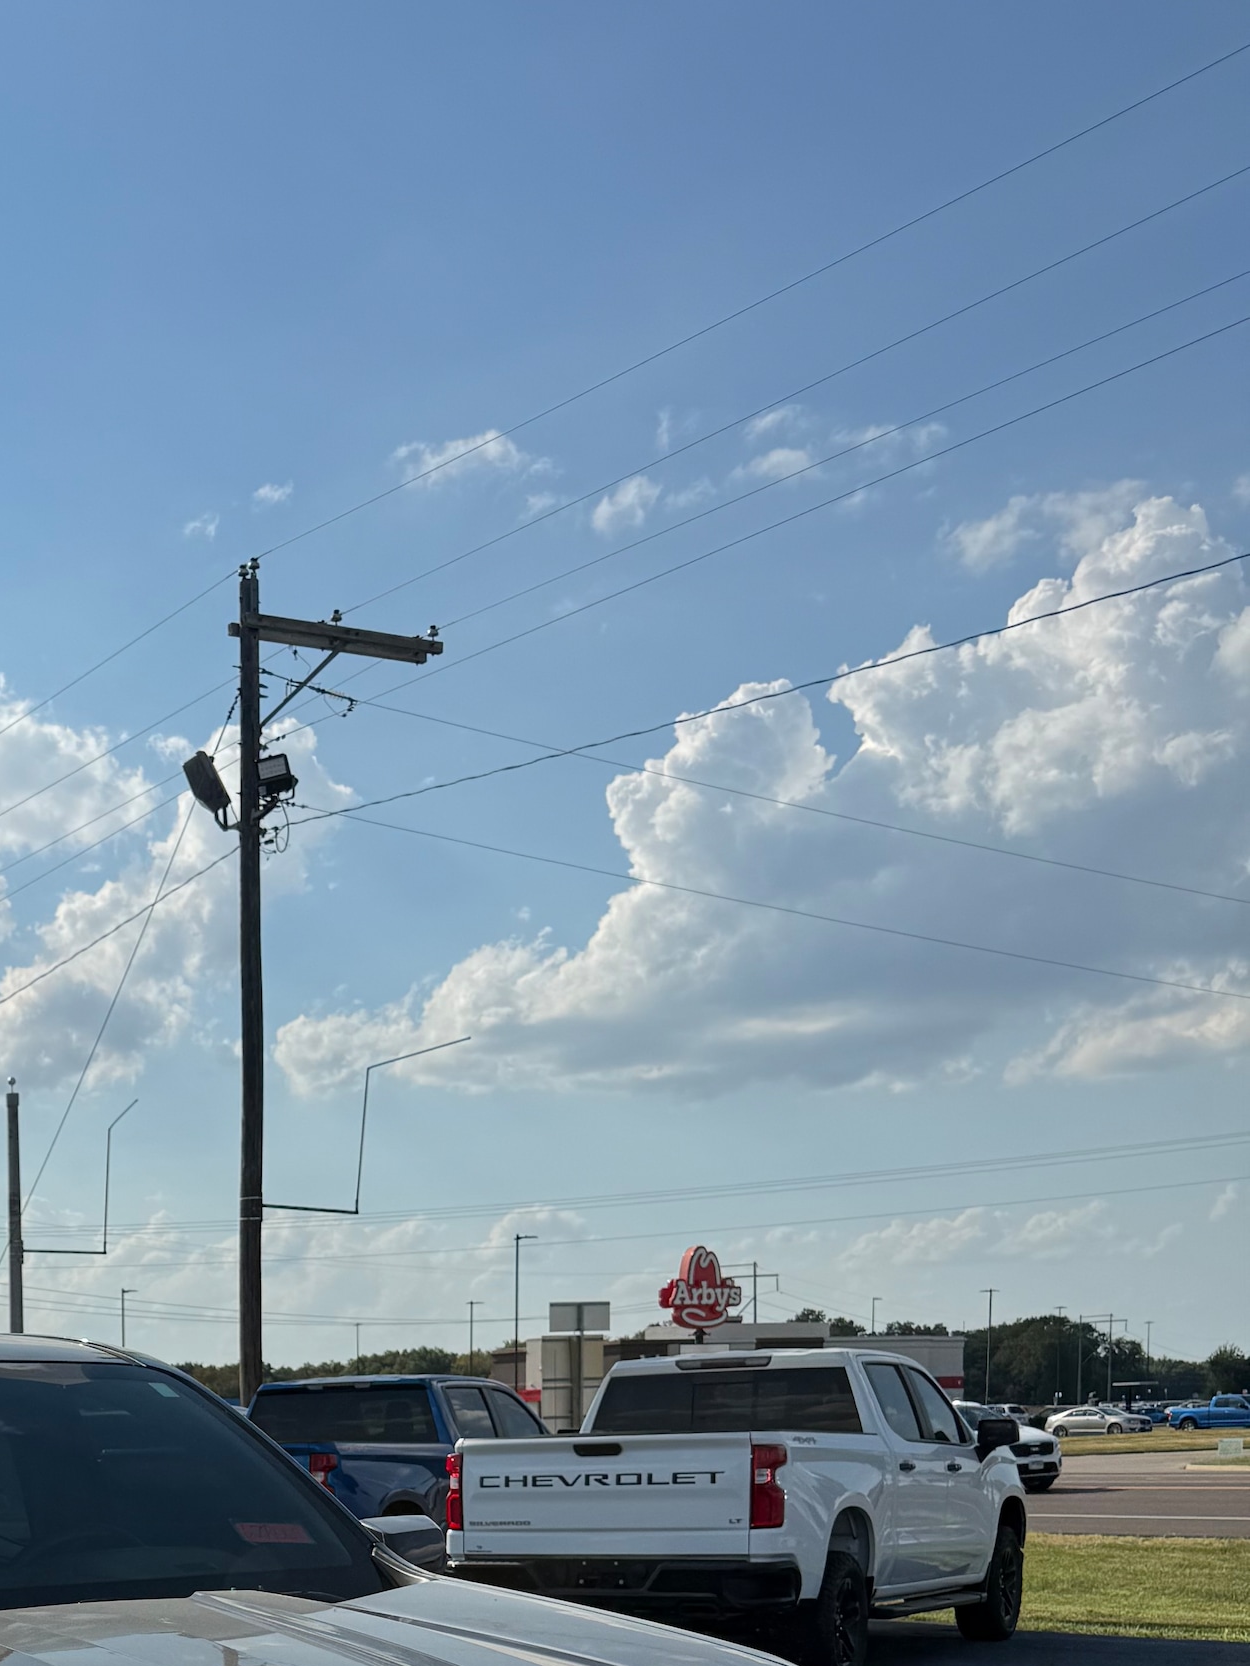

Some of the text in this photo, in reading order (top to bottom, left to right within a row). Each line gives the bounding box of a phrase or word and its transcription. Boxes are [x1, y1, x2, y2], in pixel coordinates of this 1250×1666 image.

[672, 1278, 742, 1312] Arby's
[479, 1470, 725, 1489] CHEVROLET
[728, 1517, 743, 1525] LT
